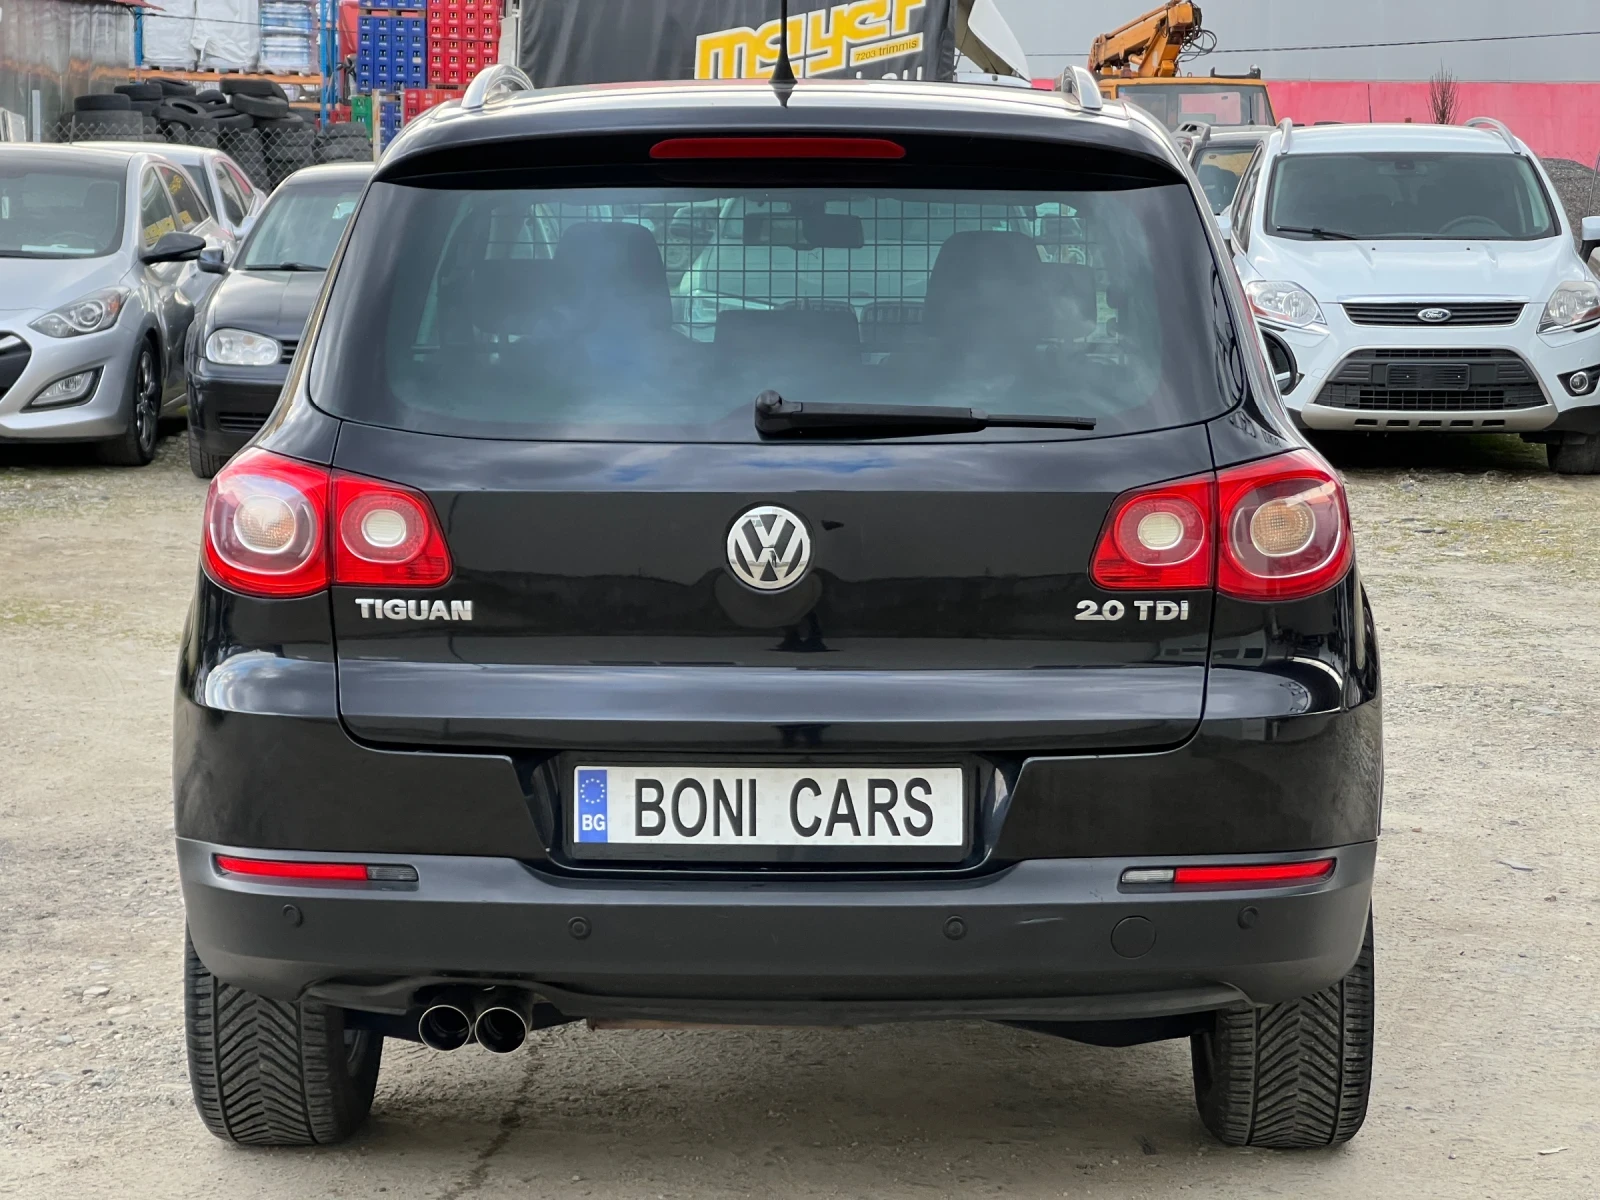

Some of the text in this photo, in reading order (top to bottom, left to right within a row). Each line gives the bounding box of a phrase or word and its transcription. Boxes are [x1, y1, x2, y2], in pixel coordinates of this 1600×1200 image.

[695, 0, 925, 79] mayer
[855, 39, 918, 62] 7203 trimmis
[355, 598, 472, 620] TIGUAN
[1133, 600, 1189, 621] TDI
[634, 776, 935, 838] BONI CARS
[581, 813, 606, 832] BG
